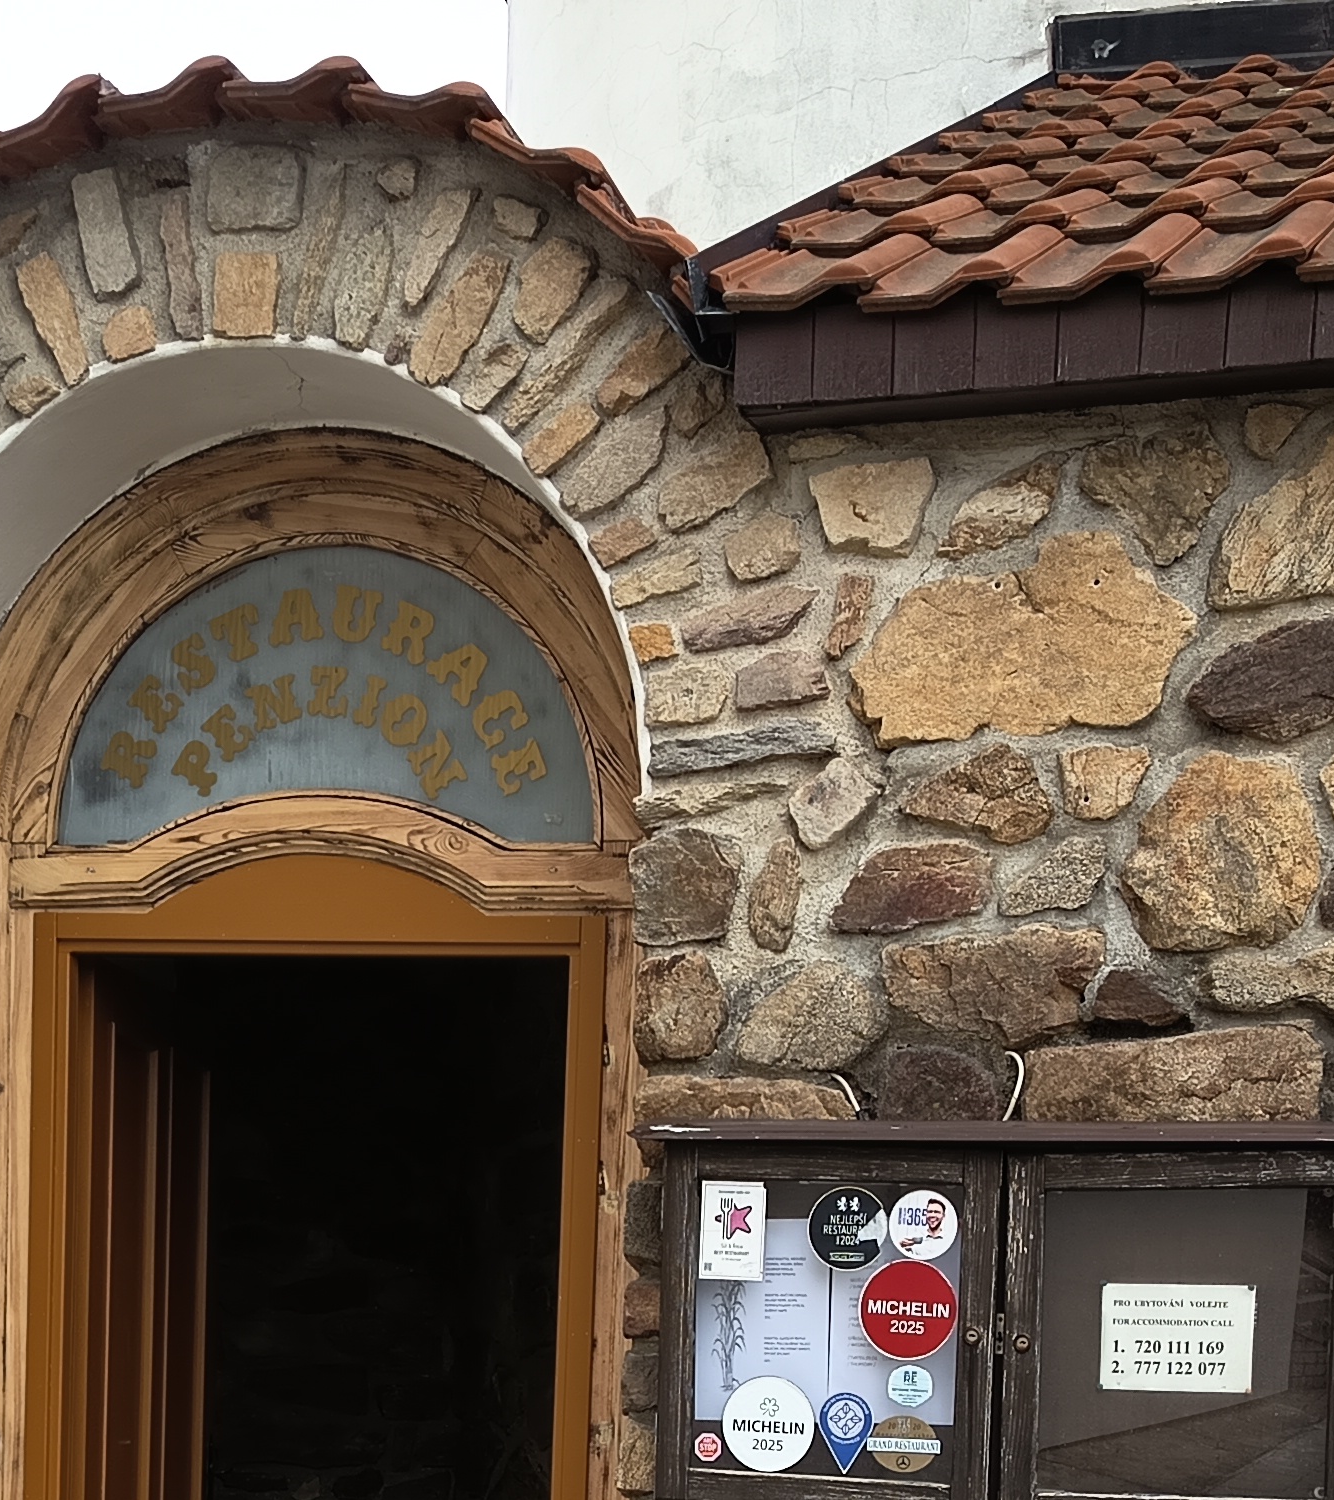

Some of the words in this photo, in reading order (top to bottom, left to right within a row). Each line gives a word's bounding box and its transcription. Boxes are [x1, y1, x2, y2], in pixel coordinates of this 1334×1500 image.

[101, 585, 547, 796] RESTAURACE
[172, 666, 467, 800] PENZION
[830, 1212, 867, 1225] NEJLEPŠÍ
[823, 1225, 863, 1235] RESTAURA
[867, 1299, 950, 1318] MICHELIN
[1113, 1299, 1131, 1307] PRO
[1134, 1298, 1184, 1308] UBYTOVÁNÍ
[1190, 1301, 1229, 1309] VOLEJTE
[890, 1319, 925, 1335] 2025
[1130, 1318, 1209, 1327] ACCOMMODATION
[1210, 1319, 1234, 1327] CALL
[1113, 1340, 1125, 1353] 1.
[1135, 1340, 1162, 1354] 720
[1168, 1340, 1190, 1354] 111
[1198, 1341, 1225, 1355] 169
[1111, 1360, 1125, 1374] 2.
[1134, 1361, 1161, 1375] 777
[1167, 1361, 1193, 1375] 122
[1198, 1362, 1226, 1376] 077
[732, 1419, 805, 1435] MICHELIN
[752, 1438, 784, 1452] 2025
[868, 1440, 893, 1451] GRAND
[894, 1441, 939, 1452] RESTAURANT
